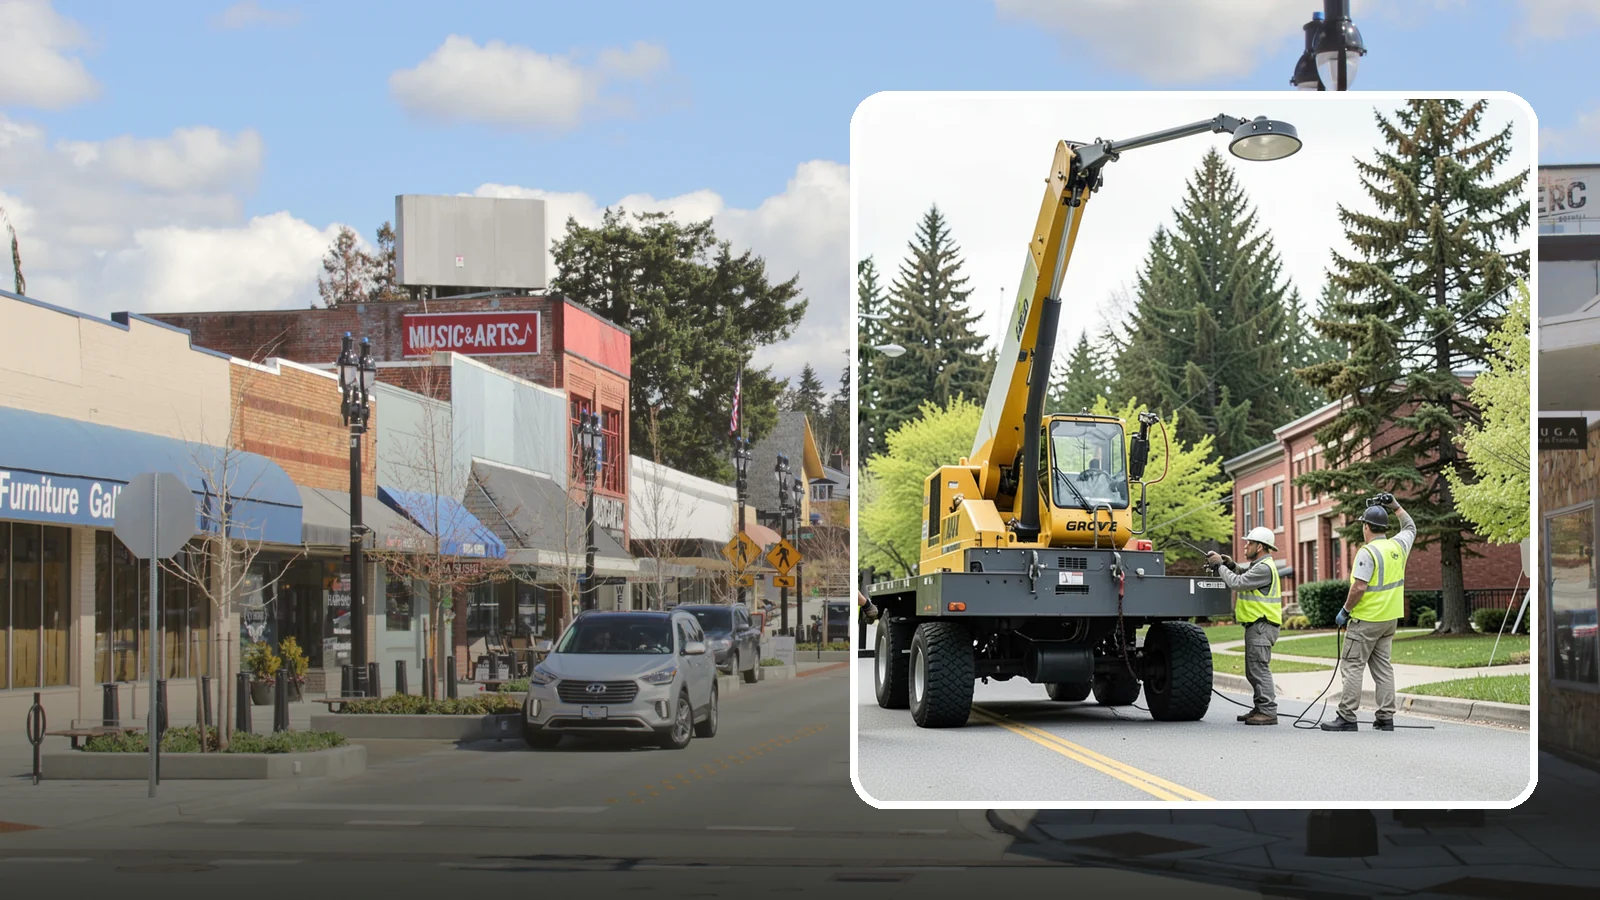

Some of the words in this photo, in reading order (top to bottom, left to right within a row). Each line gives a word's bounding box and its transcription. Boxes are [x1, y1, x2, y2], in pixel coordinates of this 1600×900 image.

[0, 472, 79, 515] Furniture
[89, 482, 122, 519] Gal
[1066, 521, 1118, 531] GROVE
[453, 563, 479, 574] SUSHI
